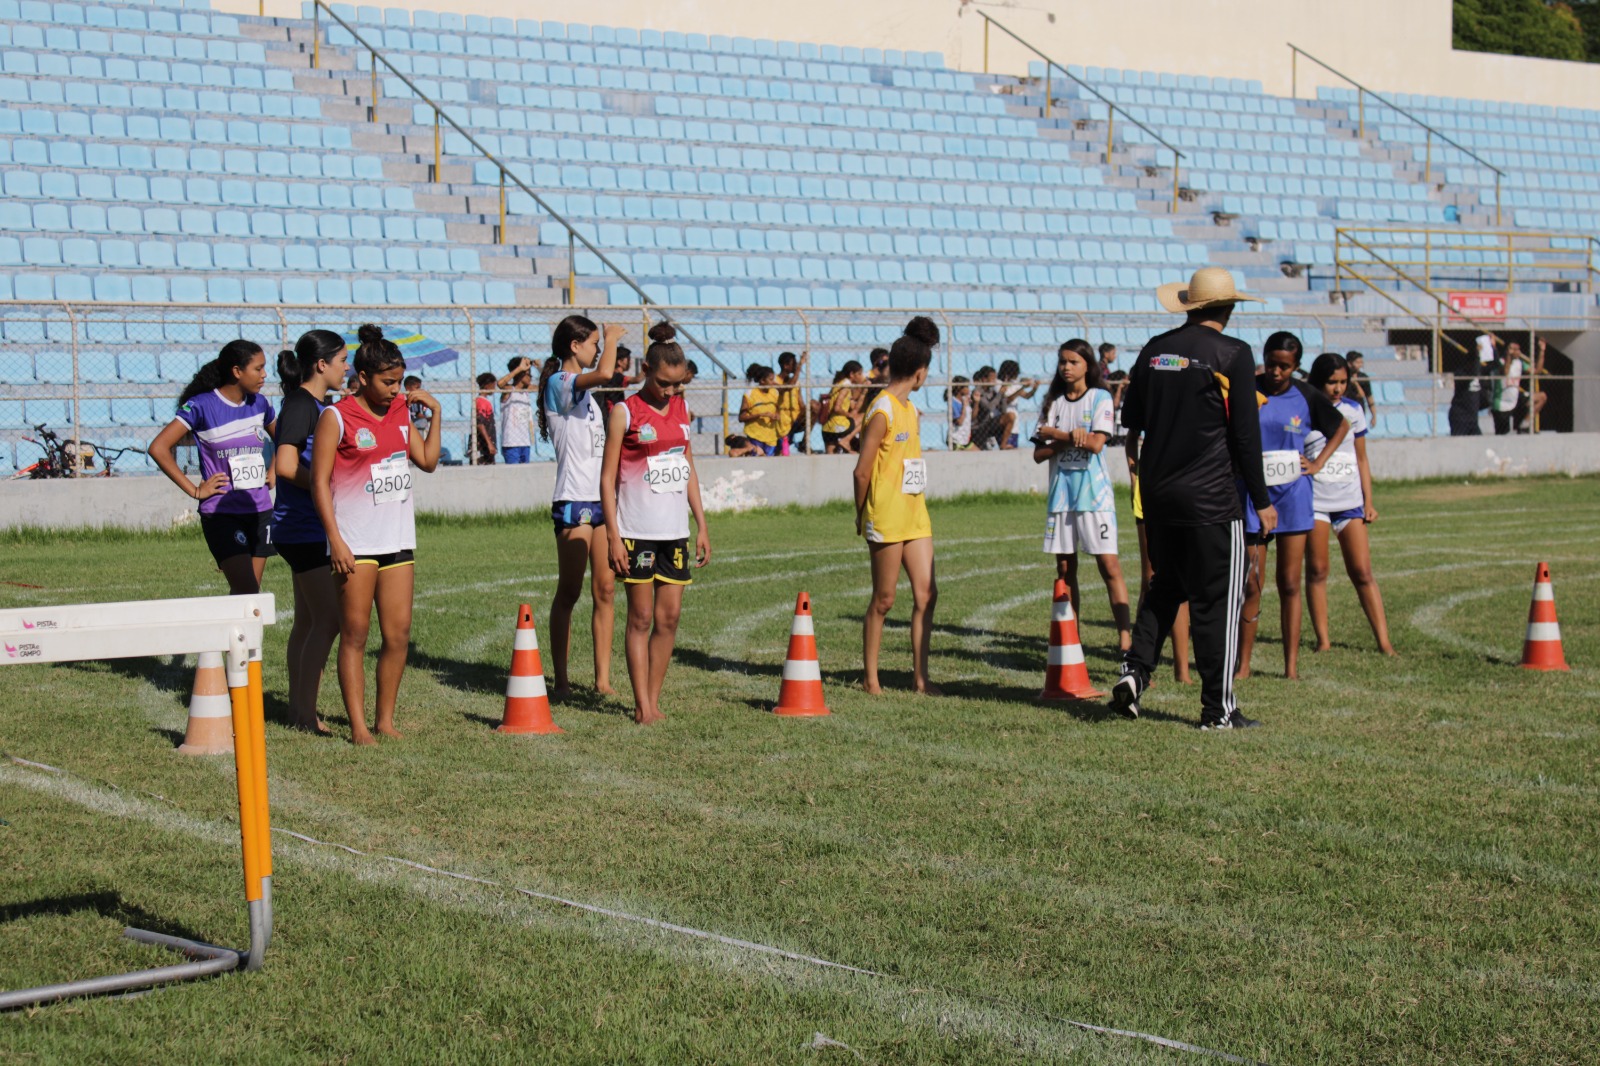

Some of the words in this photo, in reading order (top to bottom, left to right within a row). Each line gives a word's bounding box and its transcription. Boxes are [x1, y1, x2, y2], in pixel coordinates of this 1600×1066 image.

[586, 403, 595, 421] 9
[232, 464, 265, 482] 2507
[650, 465, 691, 485] 2503
[373, 473, 412, 495] 2502
[1100, 523, 1109, 540] 2
[673, 547, 684, 570] 5
[19, 650, 42, 658] CAMPO
